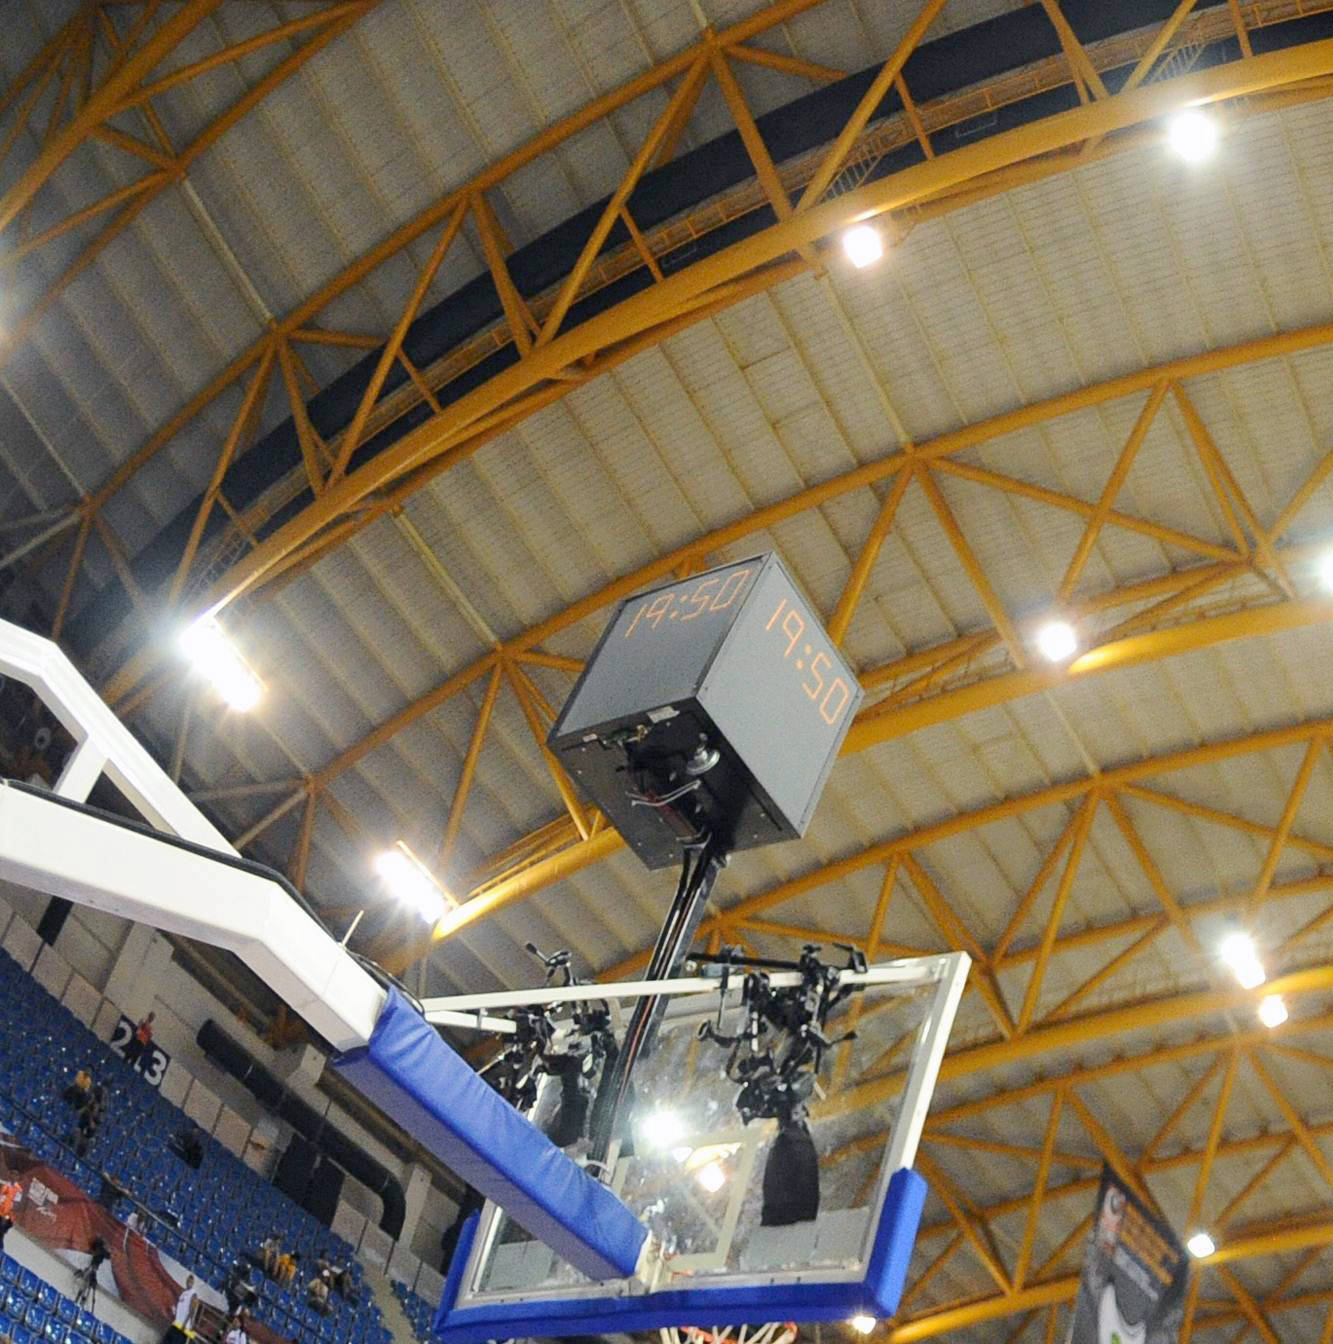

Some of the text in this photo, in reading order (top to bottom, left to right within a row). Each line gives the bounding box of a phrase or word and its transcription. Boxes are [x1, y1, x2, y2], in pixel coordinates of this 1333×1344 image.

[624, 568, 751, 638] 19:50
[765, 598, 850, 725] 19:50
[110, 1020, 167, 1086] 23
